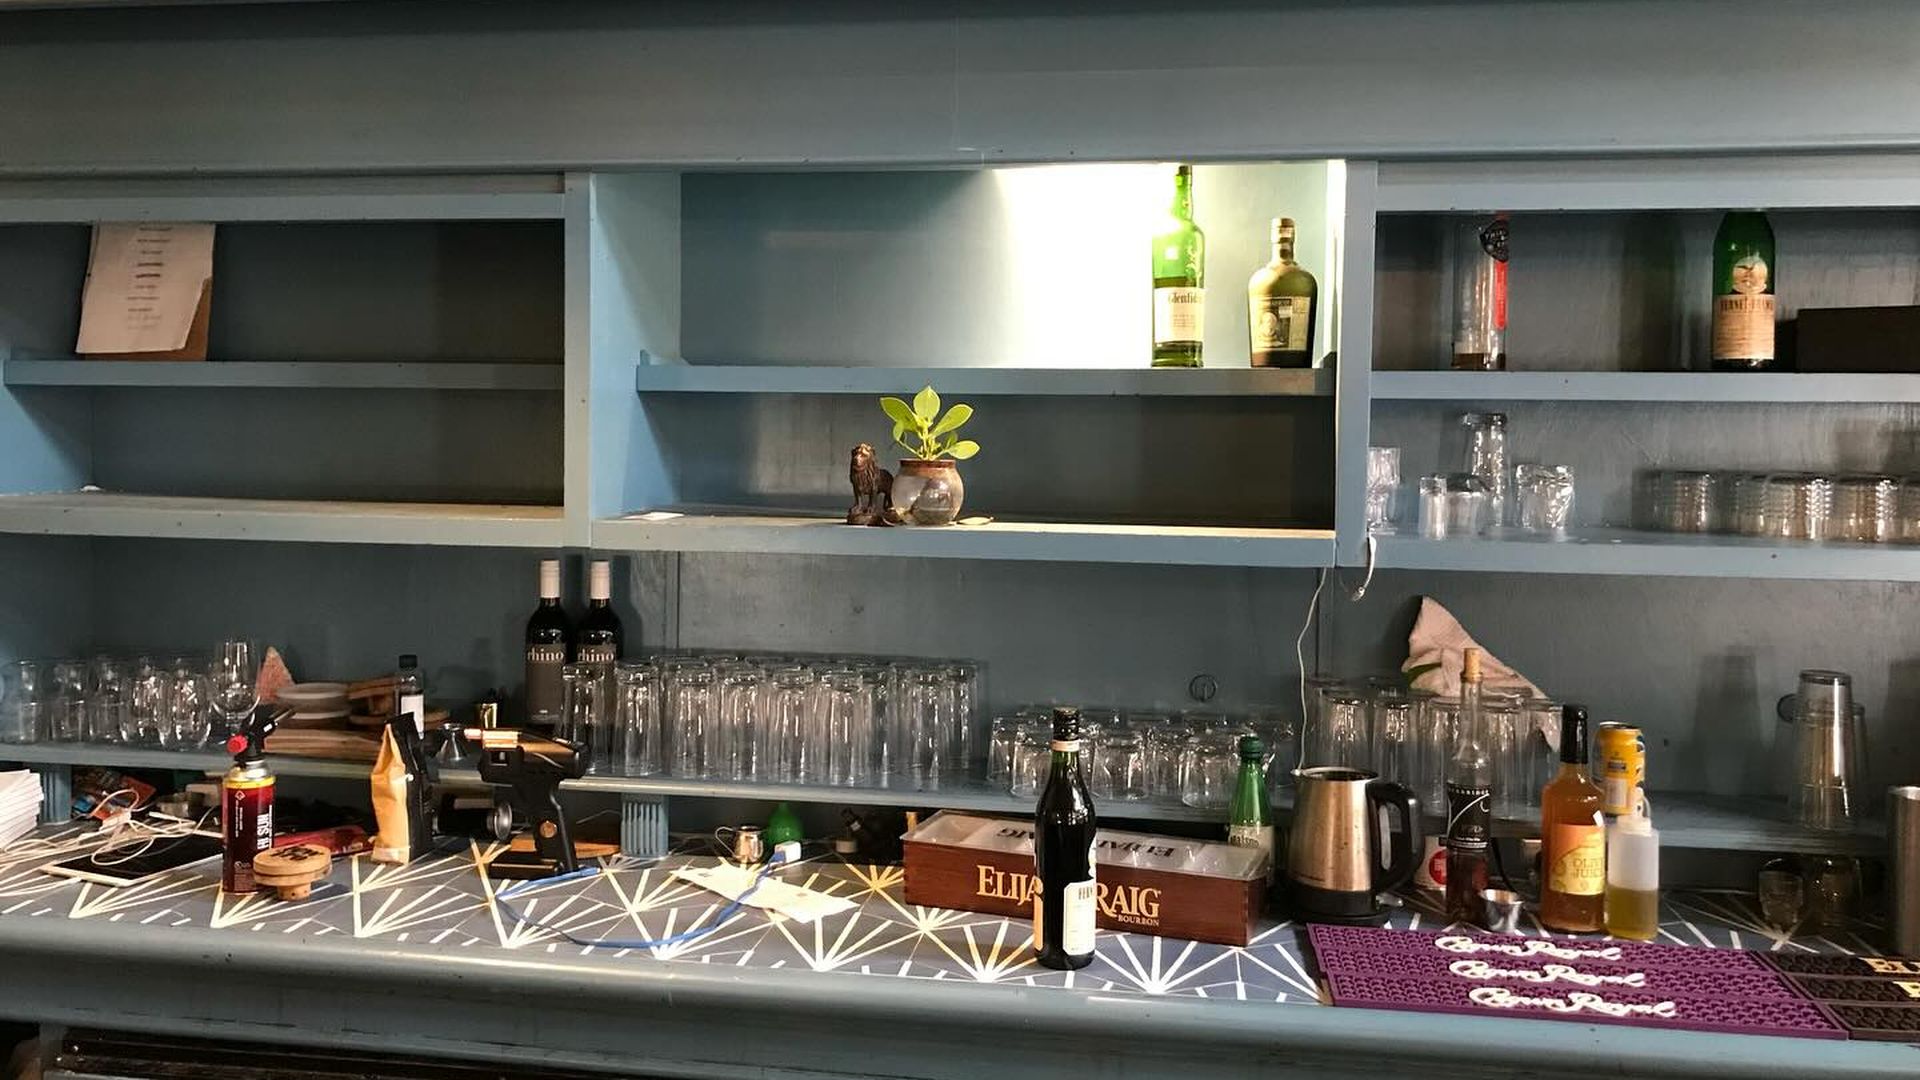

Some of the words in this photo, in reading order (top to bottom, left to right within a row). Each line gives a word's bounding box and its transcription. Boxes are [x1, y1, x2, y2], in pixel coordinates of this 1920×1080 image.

[527, 647, 564, 661] rhino
[577, 648, 614, 661] rhino
[976, 864, 1038, 906] ELIJA
[1096, 881, 1162, 918] RAIG
[1117, 914, 1160, 927] BOURBON
[1435, 936, 1526, 956] Crown
[1521, 940, 1621, 961] Royal
[1449, 960, 1541, 982] Crown
[1538, 964, 1646, 986] Royal
[1469, 987, 1569, 1011] Crown
[1563, 992, 1677, 1017] Royal
